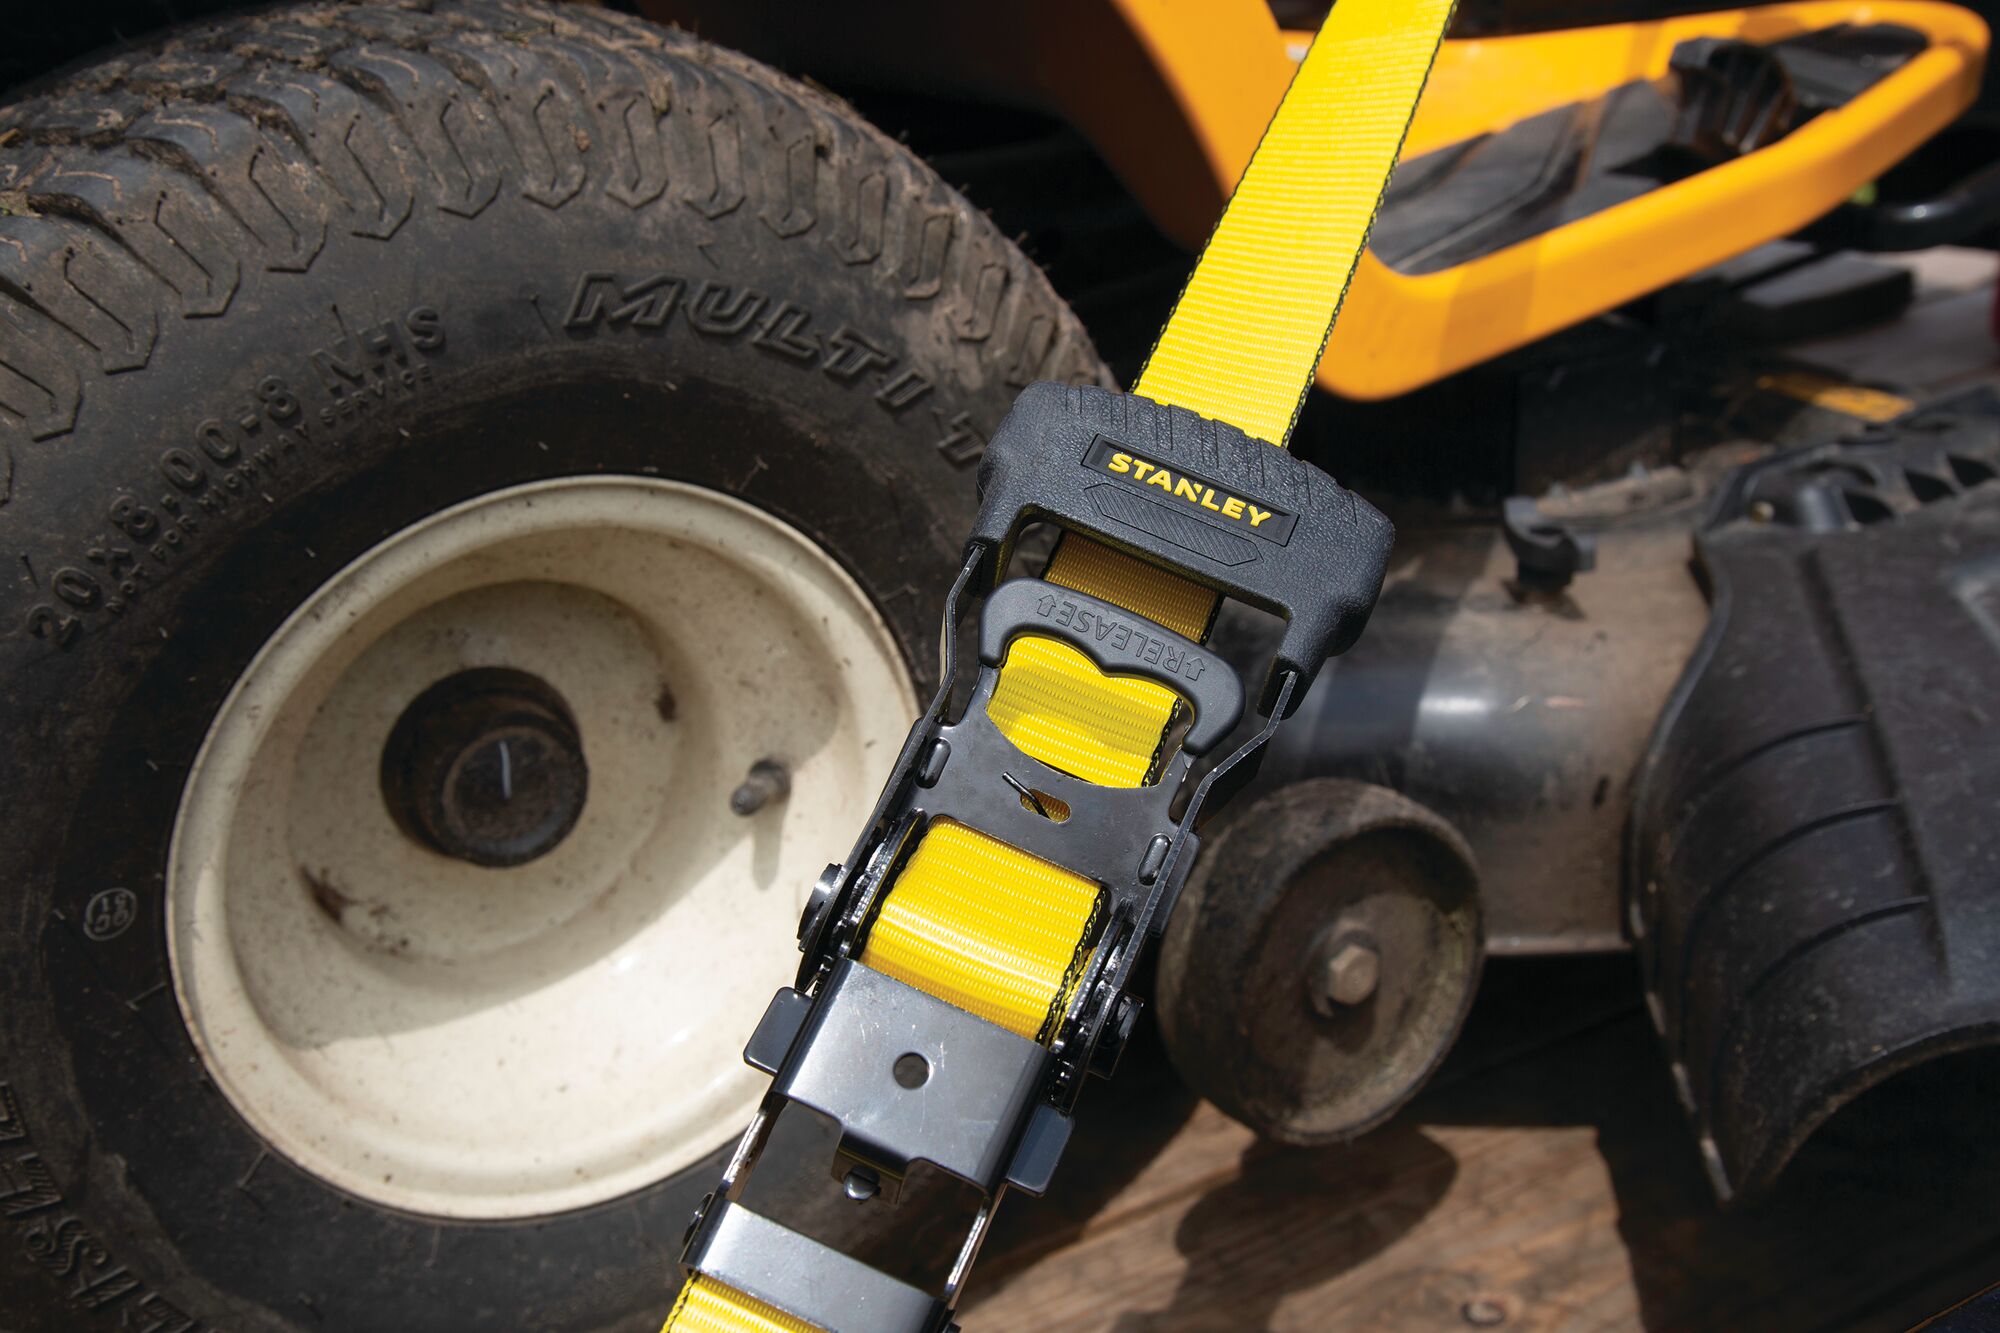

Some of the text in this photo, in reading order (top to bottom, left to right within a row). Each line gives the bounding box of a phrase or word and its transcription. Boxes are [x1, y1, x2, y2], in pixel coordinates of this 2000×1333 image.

[310, 304, 447, 394] NHS
[563, 269, 934, 409] MULTI
[105, 361, 433, 617] NOT FOR HIGHWAY SERVICE
[1108, 452, 1272, 527] STANLEY
[1055, 599, 1186, 674] RELEASE
